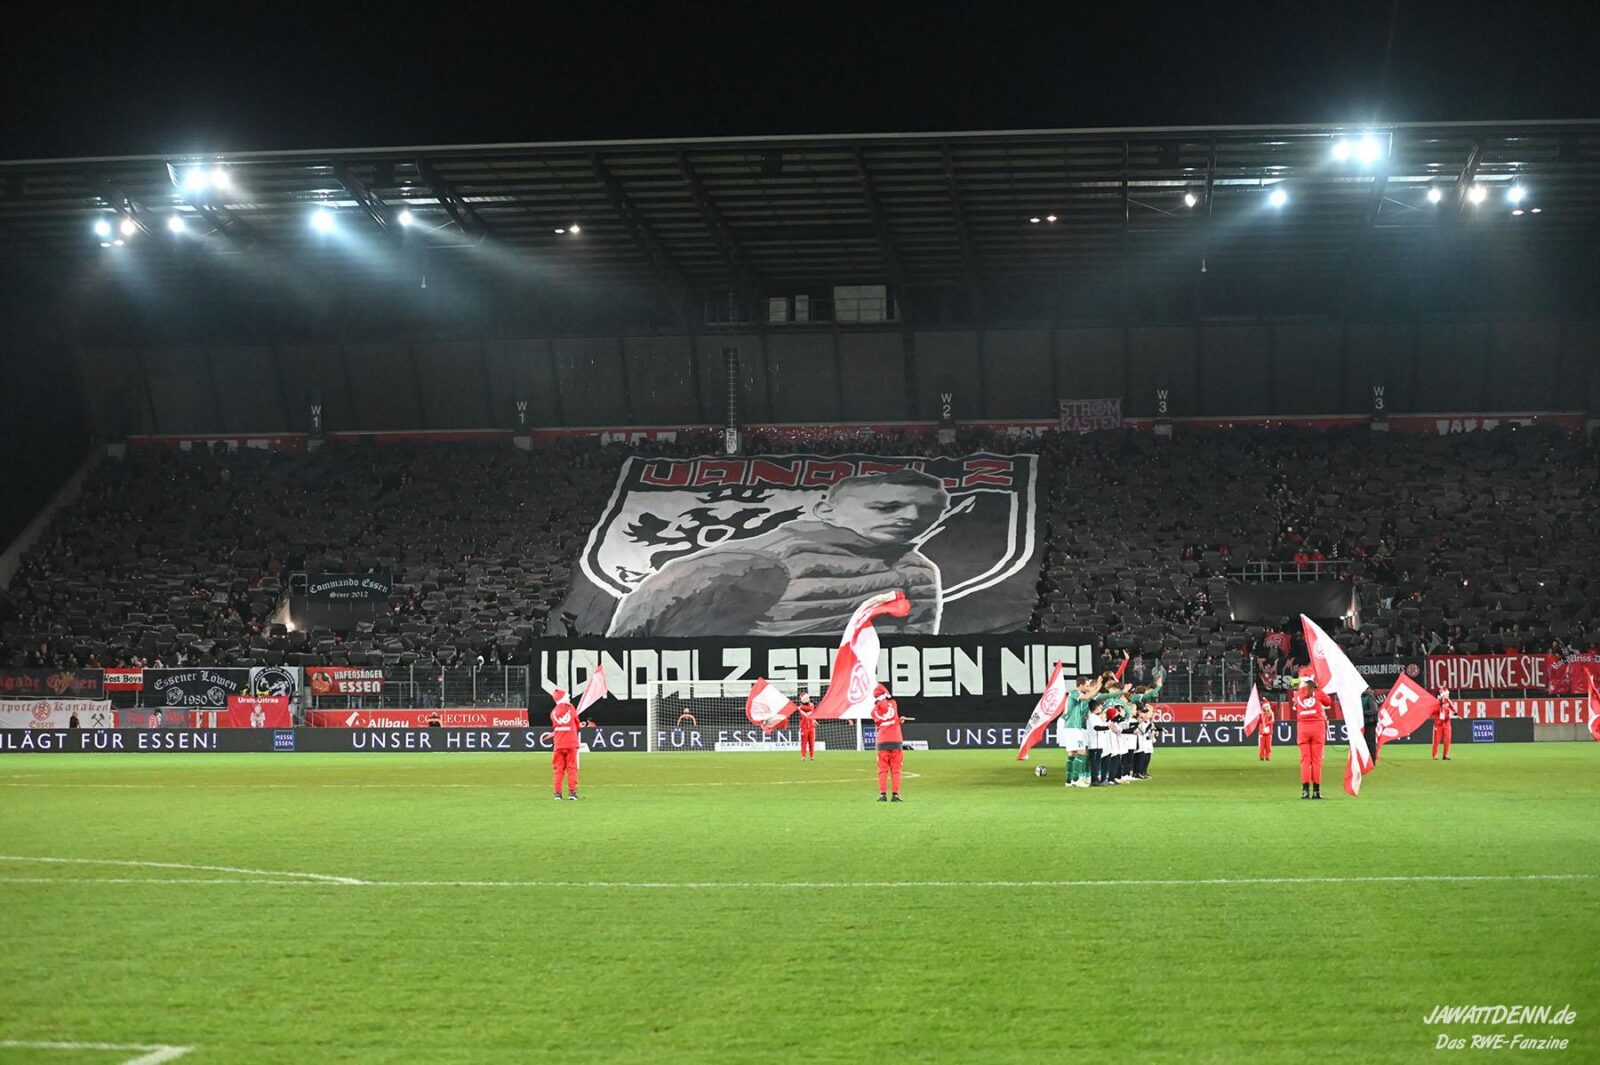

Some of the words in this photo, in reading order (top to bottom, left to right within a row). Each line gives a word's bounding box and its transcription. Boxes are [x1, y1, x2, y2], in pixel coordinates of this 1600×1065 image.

[1157, 390, 1168, 400] W
[1374, 386, 1385, 396] W
[941, 393, 952, 403] W
[1375, 398, 1384, 409] 3
[311, 405, 321, 414] W
[517, 402, 527, 411] W
[1158, 402, 1167, 413] 3
[1060, 416, 1121, 431] KASTEN
[310, 578, 359, 593] Commando
[362, 578, 388, 593] Essen
[1001, 644, 1092, 696] NIE!
[1429, 658, 1457, 689] ICH
[1460, 657, 1517, 688] DANKE
[1521, 655, 1545, 687] SIE
[123, 674, 142, 683] Boys
[154, 673, 197, 690] Essener
[200, 670, 237, 691] Löwen
[339, 681, 381, 692] ESSEN
[183, 694, 208, 705] 1980
[1501, 700, 1583, 724] CHANCE
[367, 717, 409, 728] Allbau
[0, 730, 67, 749] LÄGT
[81, 730, 124, 749] FÜR
[138, 732, 217, 748] ESSEN!
[352, 732, 432, 748] UNSER
[447, 732, 511, 748] HERZ
[525, 729, 642, 748] SCLÄGT
[657, 728, 703, 747] FÜR
